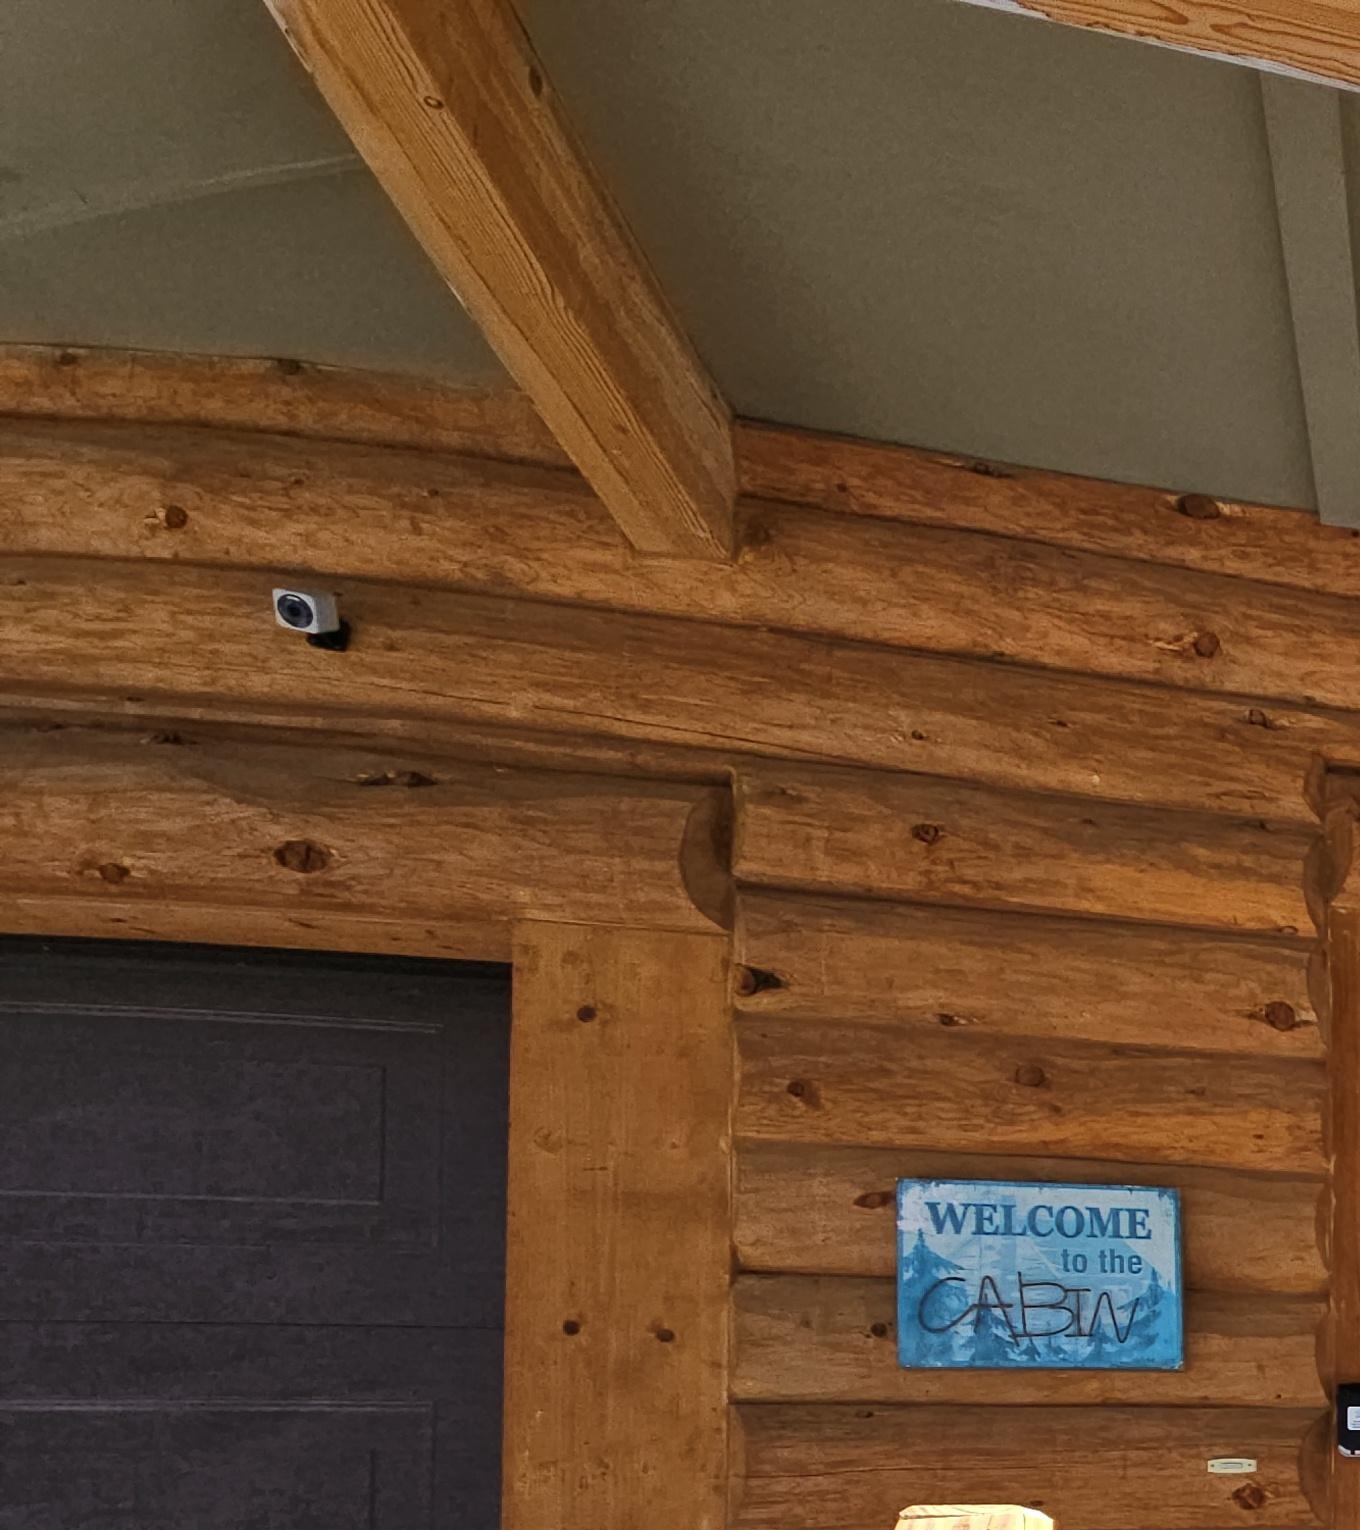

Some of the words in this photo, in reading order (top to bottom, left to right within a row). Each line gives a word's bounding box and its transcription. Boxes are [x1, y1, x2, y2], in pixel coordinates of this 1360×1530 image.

[924, 1201, 1152, 1239] WELCOME
[1061, 1248, 1088, 1274] to
[1099, 1248, 1143, 1275] the
[918, 1271, 1140, 1347] CABIN
